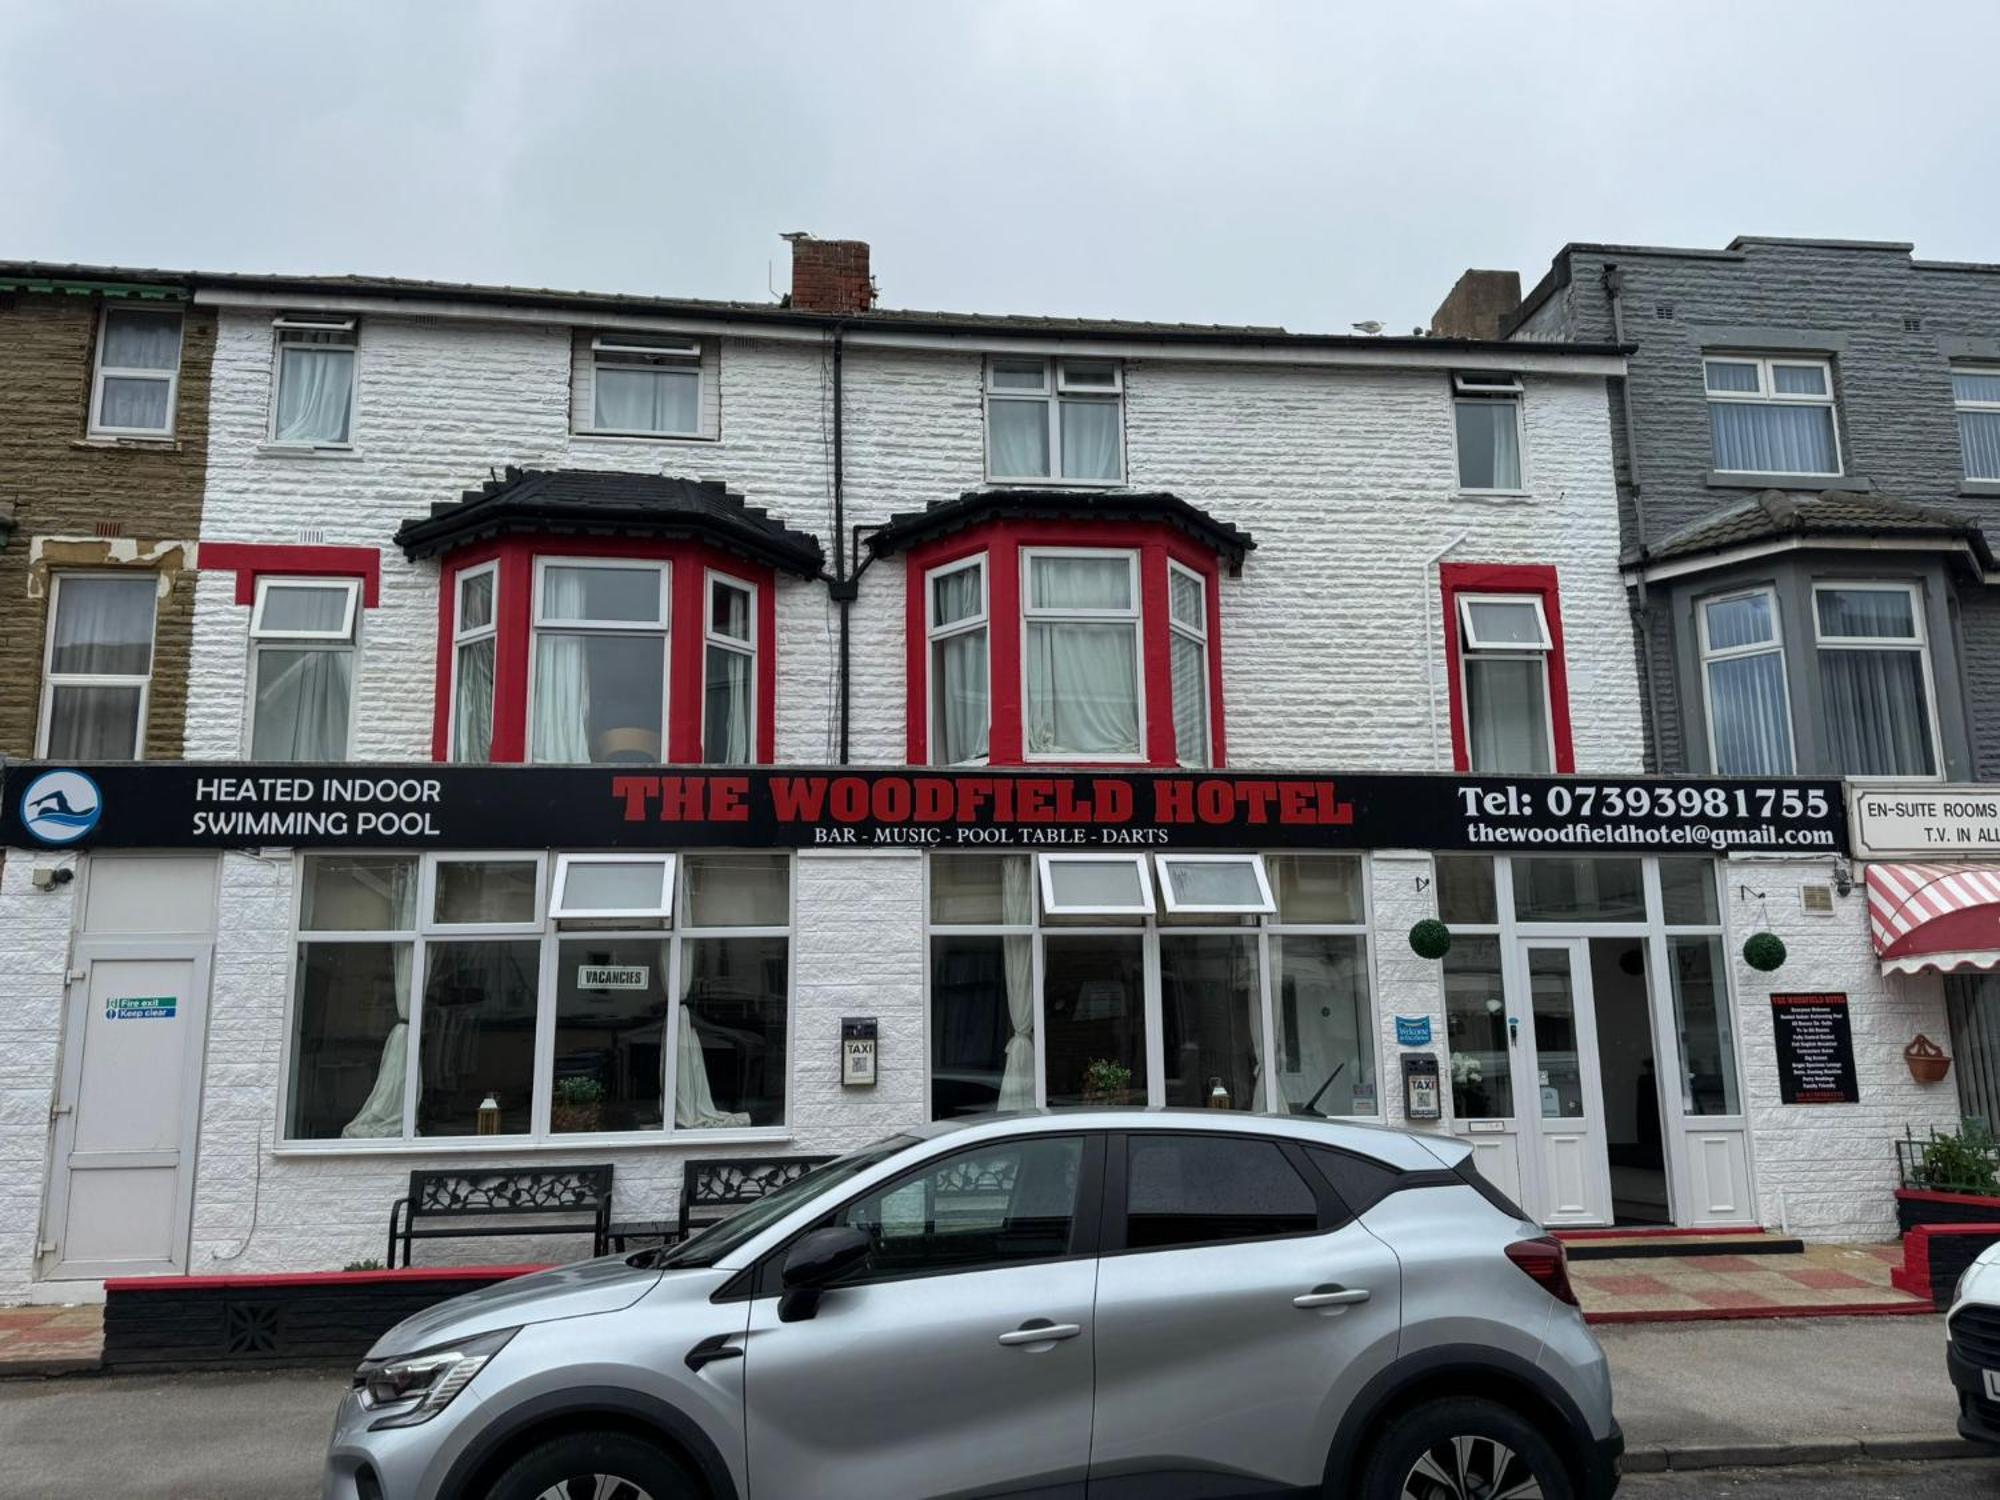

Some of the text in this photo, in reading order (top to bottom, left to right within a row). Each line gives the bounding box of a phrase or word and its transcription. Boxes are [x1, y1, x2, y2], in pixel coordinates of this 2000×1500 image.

[195, 778, 441, 802] HEATED INDOOR
[612, 776, 1354, 825] THE WOODFIELD HOTEL
[1457, 786, 1829, 818] Tel: 07393981755
[1867, 803, 1998, 818] EN-SUITE ROOMS
[193, 812, 441, 836] SWIMMING POOL
[814, 828, 856, 843] BAR
[873, 828, 941, 844] MUSIC
[957, 828, 1014, 844] POOL
[1018, 829, 1087, 844] TABLE
[1102, 829, 1169, 844] DARTS
[1467, 823, 1834, 849] thewoodfieldhotel@gmail.com
[1924, 827, 1951, 842] T.V.
[1957, 828, 1971, 842] IN
[586, 970, 642, 984] VACANCIES
[121, 998, 159, 1008] Fire exit
[120, 1008, 166, 1018] Keep clear
[847, 1044, 873, 1054] TAXI
[1411, 1079, 1435, 1090] TAXI
